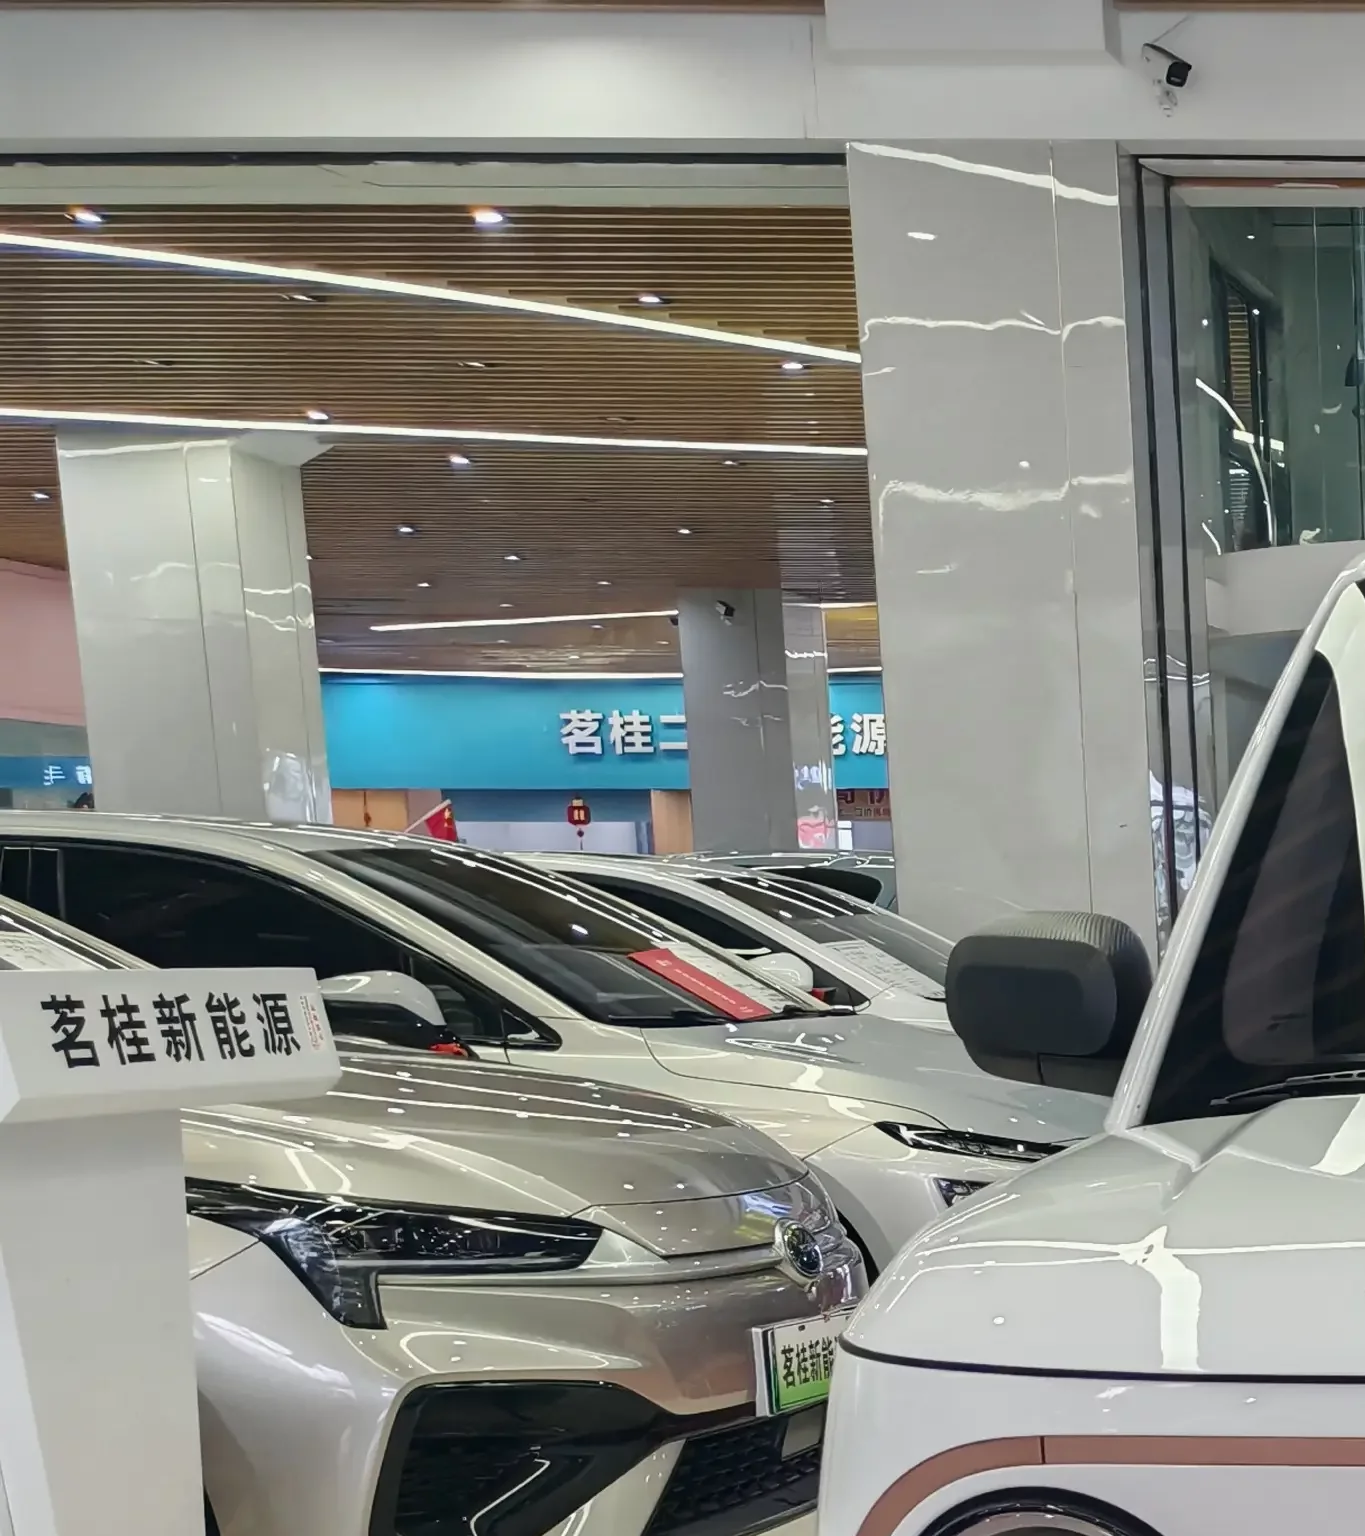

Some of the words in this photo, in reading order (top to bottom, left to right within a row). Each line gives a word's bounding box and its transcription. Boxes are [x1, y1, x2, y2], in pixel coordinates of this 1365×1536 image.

[40, 992, 301, 1069] 茗桂新能源
